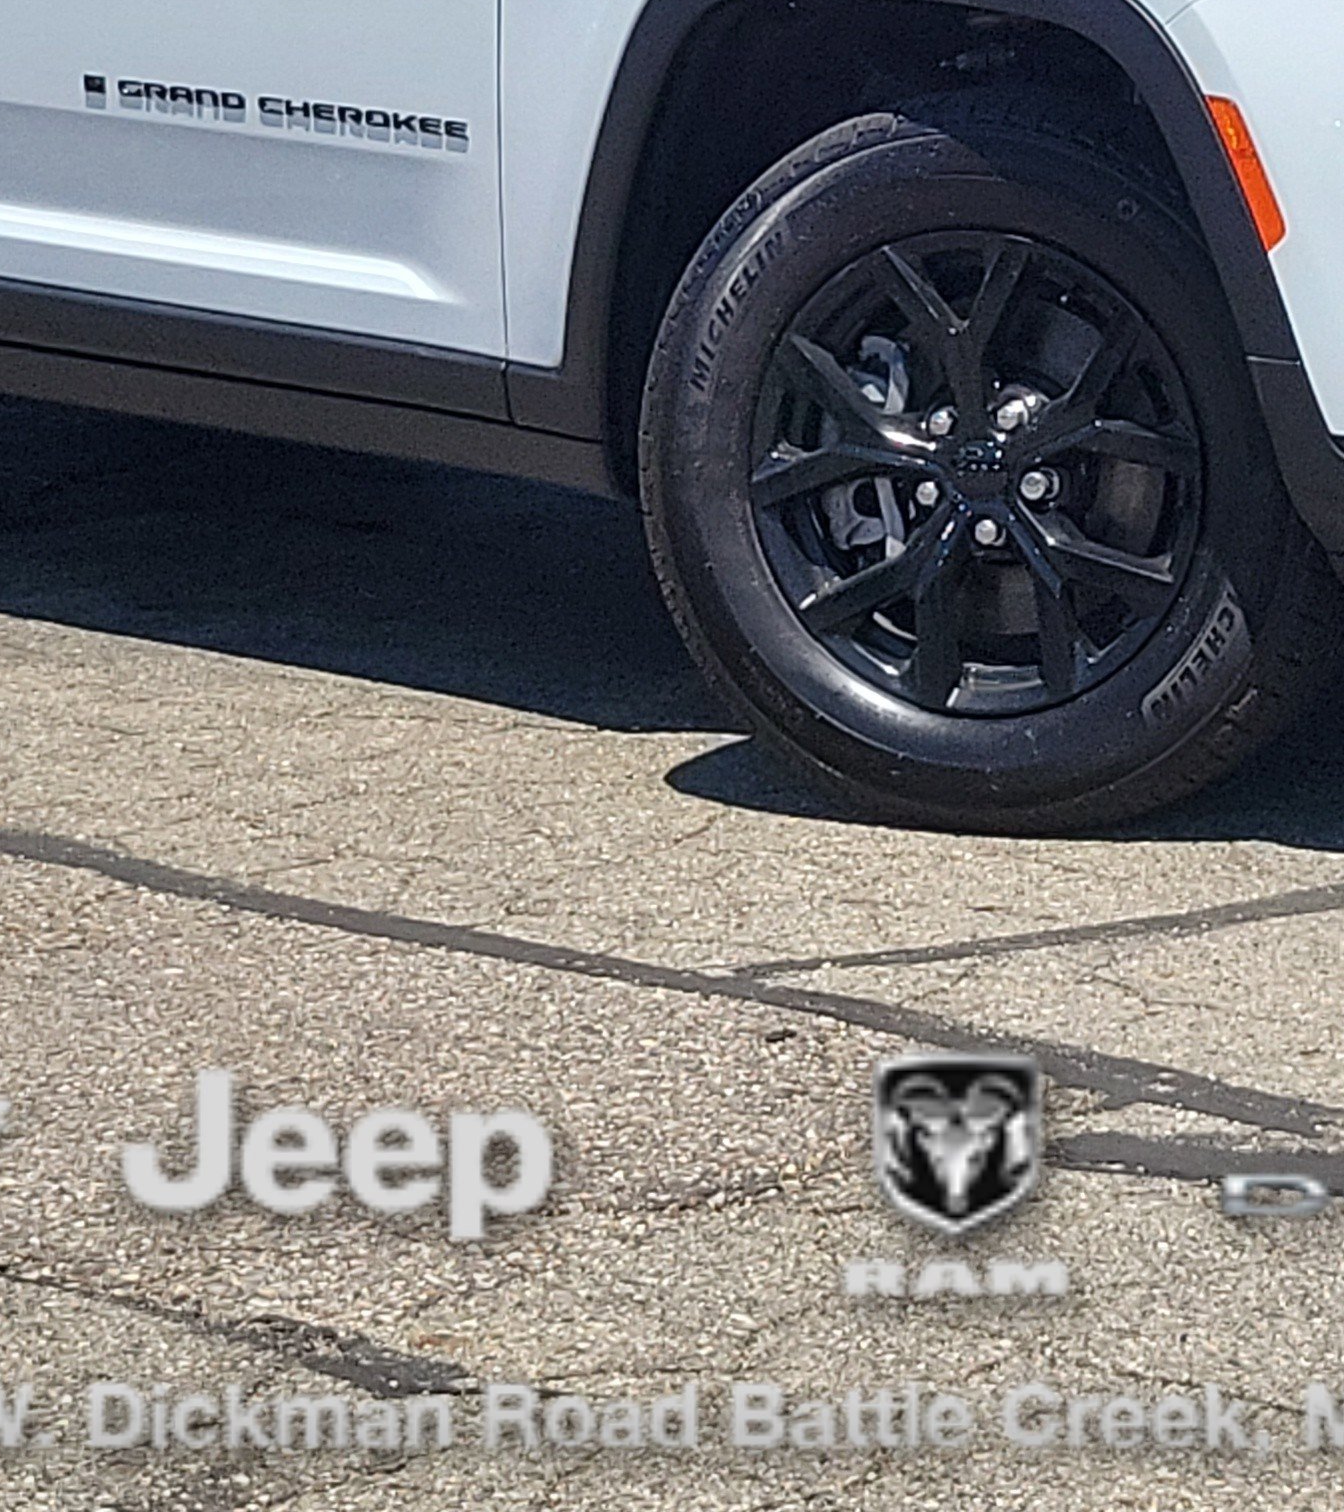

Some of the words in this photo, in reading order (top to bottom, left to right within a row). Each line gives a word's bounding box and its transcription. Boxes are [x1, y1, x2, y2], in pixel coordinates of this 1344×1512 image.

[117, 79, 246, 111] GRAND
[257, 96, 470, 141] CHEROKEE
[689, 231, 783, 390] MICHELIN
